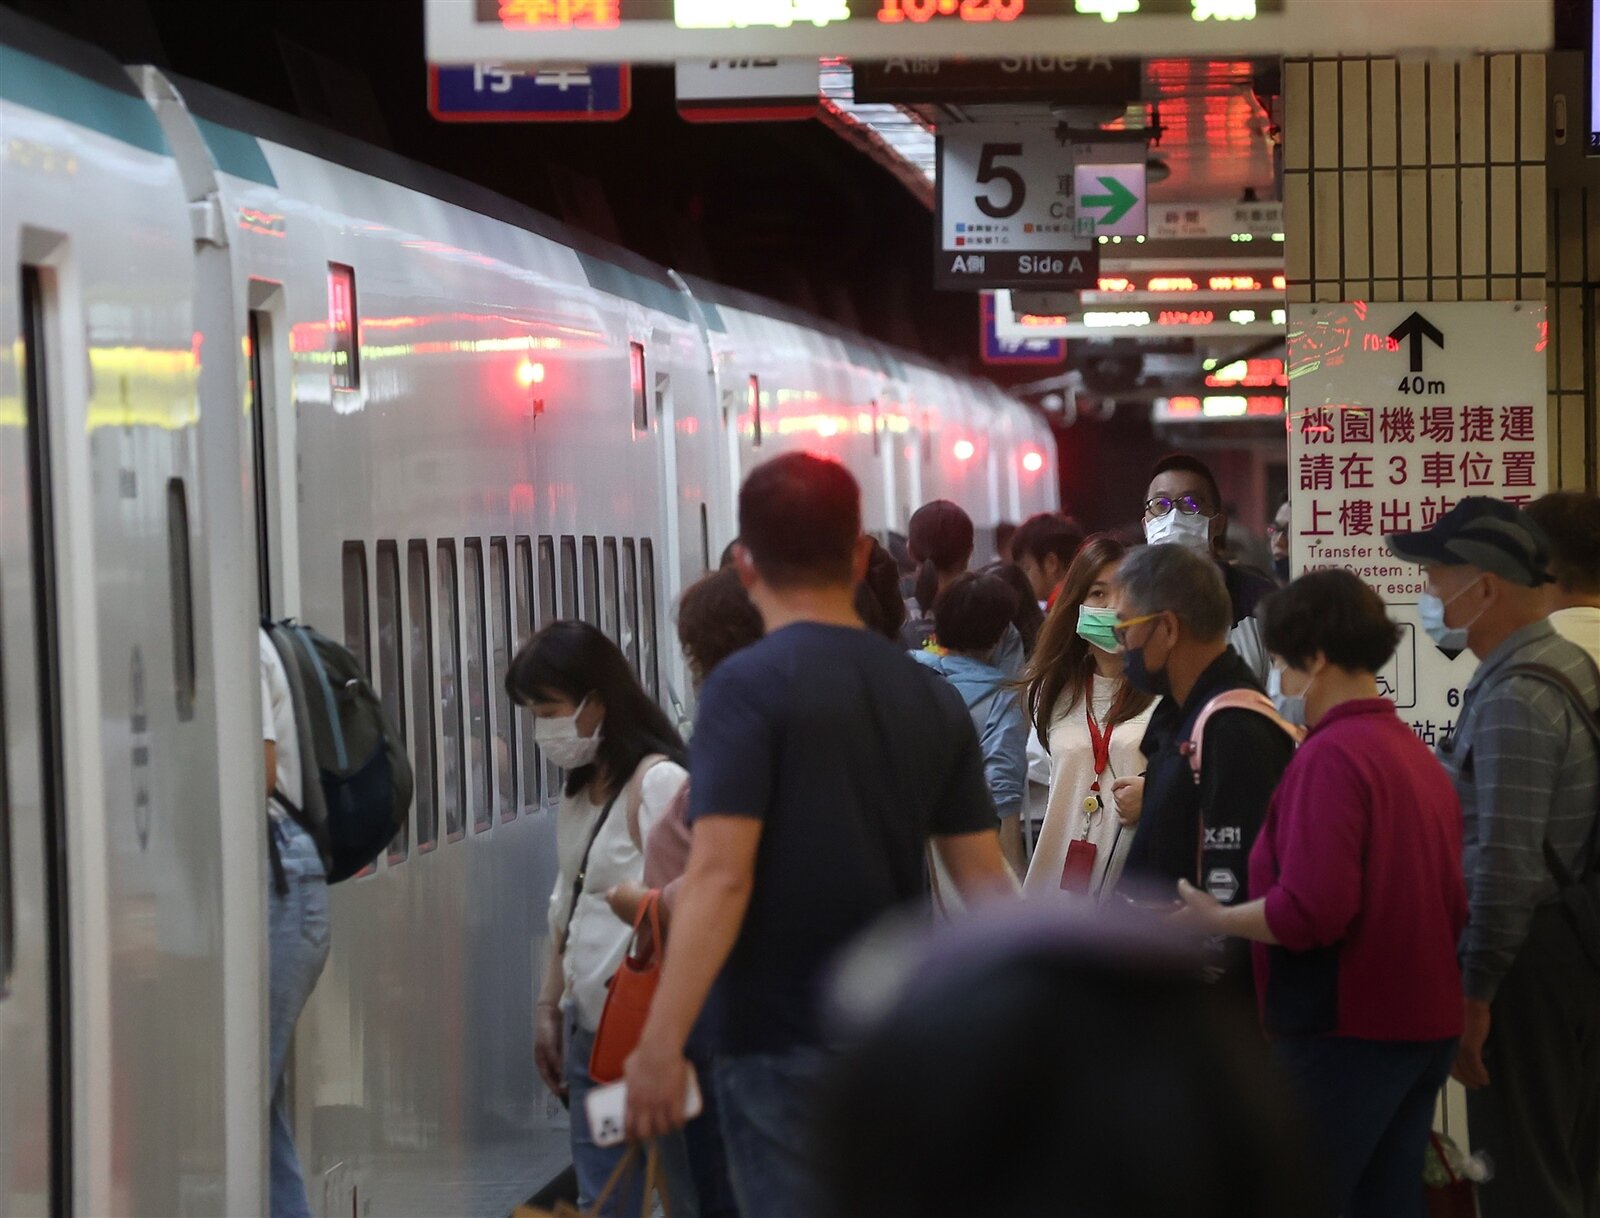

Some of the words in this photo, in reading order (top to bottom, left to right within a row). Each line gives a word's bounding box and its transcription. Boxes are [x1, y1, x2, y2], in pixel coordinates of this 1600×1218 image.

[974, 142, 1026, 219] 5
[1018, 255, 1064, 274] Side
[1068, 256, 1083, 273] A
[1398, 376, 1445, 395] 40m
[1301, 405, 1535, 445] 桃園機場捷運
[1308, 544, 1373, 558] Transfer
[1378, 545, 1394, 558] to
